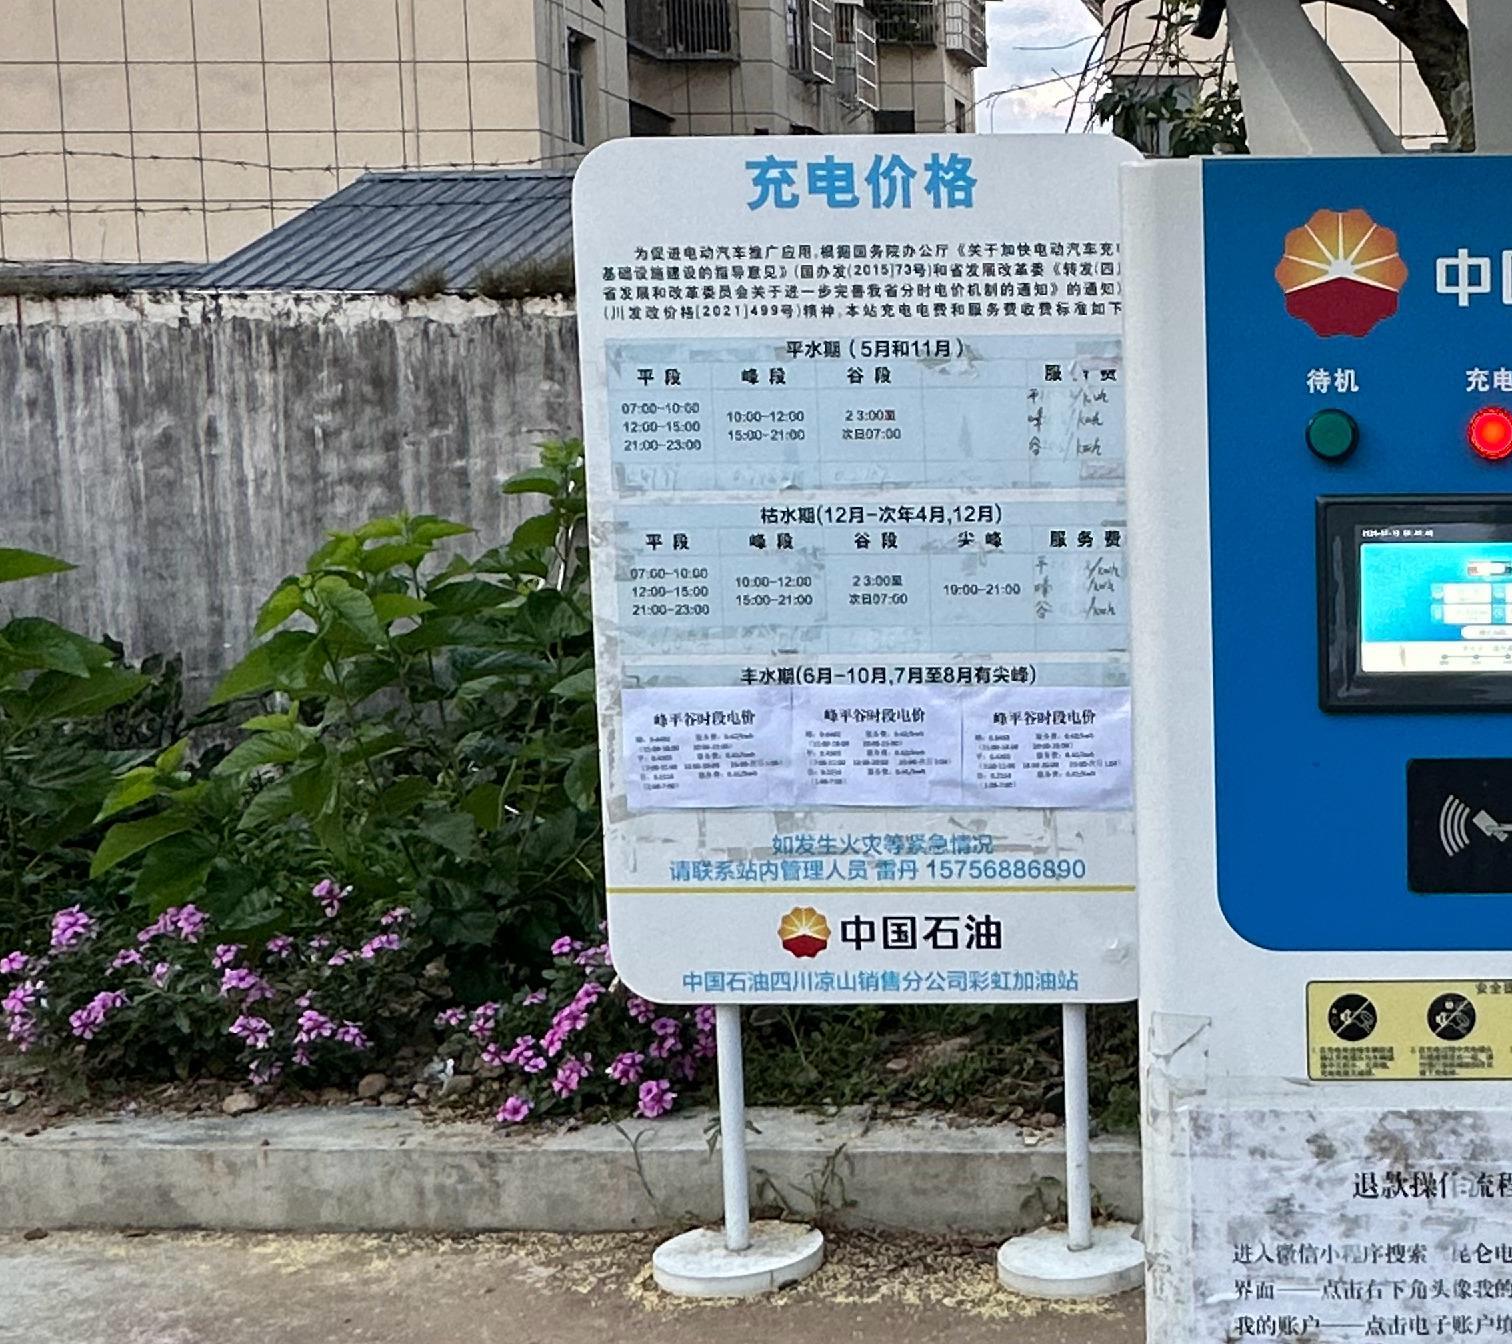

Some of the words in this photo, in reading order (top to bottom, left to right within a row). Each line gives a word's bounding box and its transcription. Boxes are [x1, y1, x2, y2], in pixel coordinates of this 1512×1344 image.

[745, 153, 977, 210] 充电价格
[637, 369, 681, 386] 平段
[741, 368, 786, 385] 峰段
[847, 367, 891, 384] 谷段
[1307, 368, 1359, 393] 待机
[622, 402, 699, 414] 07:00-10:00
[727, 411, 804, 423] 10:00-12:00
[623, 421, 700, 433] 12:00-15:00
[728, 429, 805, 441] 15:00-21:00
[842, 428, 901, 440] 次日07:00
[625, 439, 701, 451] 21:00-23:00
[646, 533, 689, 550] 平段
[749, 533, 793, 549] 峰段
[855, 532, 897, 549] 谷段
[1048, 528, 1122, 550] 服务费
[628, 568, 708, 581] 07:00-10:00
[736, 576, 811, 587] 10:00-12:00
[633, 586, 709, 597] 12:00-15:00
[736, 594, 813, 605] 15:00-21:00
[849, 593, 907, 605] 次日07:00
[633, 604, 709, 615] 21:00-23:00
[770, 832, 994, 857] 如发生火灾等紧急情况
[667, 858, 868, 884] 请联系站内管理人员
[873, 858, 919, 884] 雷丹
[923, 856, 1088, 882] 15756886890
[841, 915, 1001, 950] 中国石油
[683, 970, 1078, 992] 中国石油四川凉山销售分公司彩虹加油站
